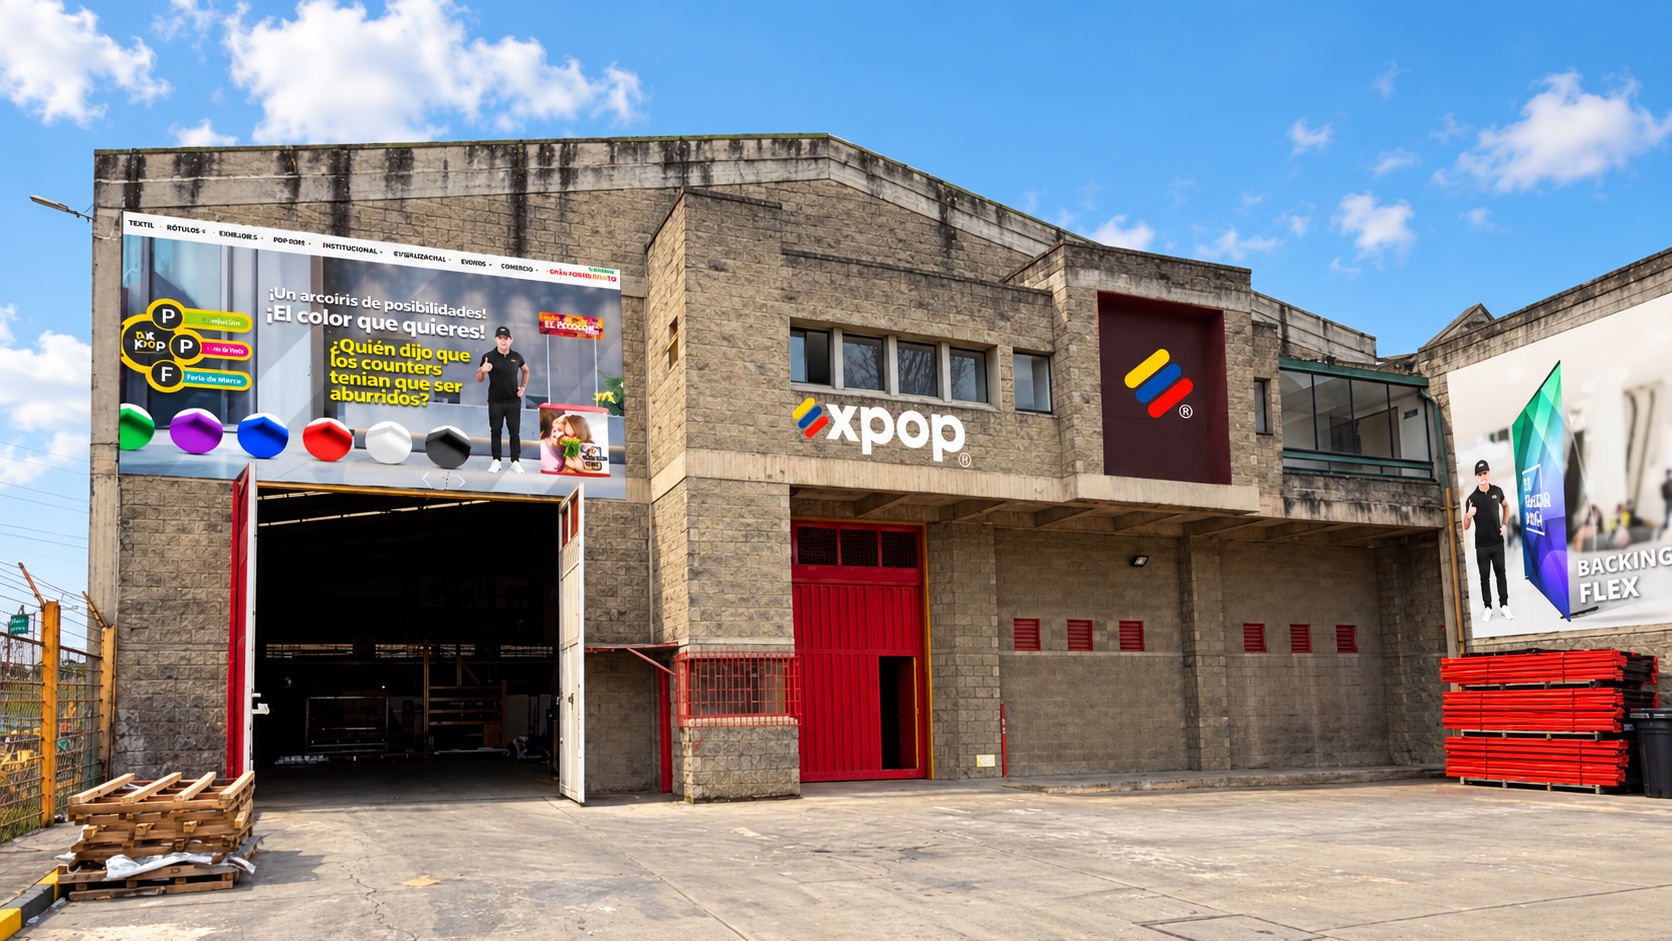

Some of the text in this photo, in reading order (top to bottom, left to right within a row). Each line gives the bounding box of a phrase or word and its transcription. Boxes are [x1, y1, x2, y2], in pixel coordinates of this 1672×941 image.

[129, 219, 155, 229] TEXTIL
[166, 223, 200, 234] RÓTULOS
[322, 241, 378, 255] INSTITUCIONAL
[500, 262, 534, 273] COMERCIO
[162, 308, 175, 323] P
[269, 287, 487, 319] ¡Un arcoíris de posibilidades!
[266, 304, 485, 340] ¡El color que quieres!
[180, 339, 193, 353] P
[330, 338, 471, 364] ¿Quién dijo que
[161, 367, 173, 381] F
[330, 352, 442, 376] los counters
[329, 370, 463, 393] tenian que ser
[330, 386, 430, 407] aburridos?
[1577, 546, 1672, 577] BACKING
[1579, 576, 1640, 603] FLEX
